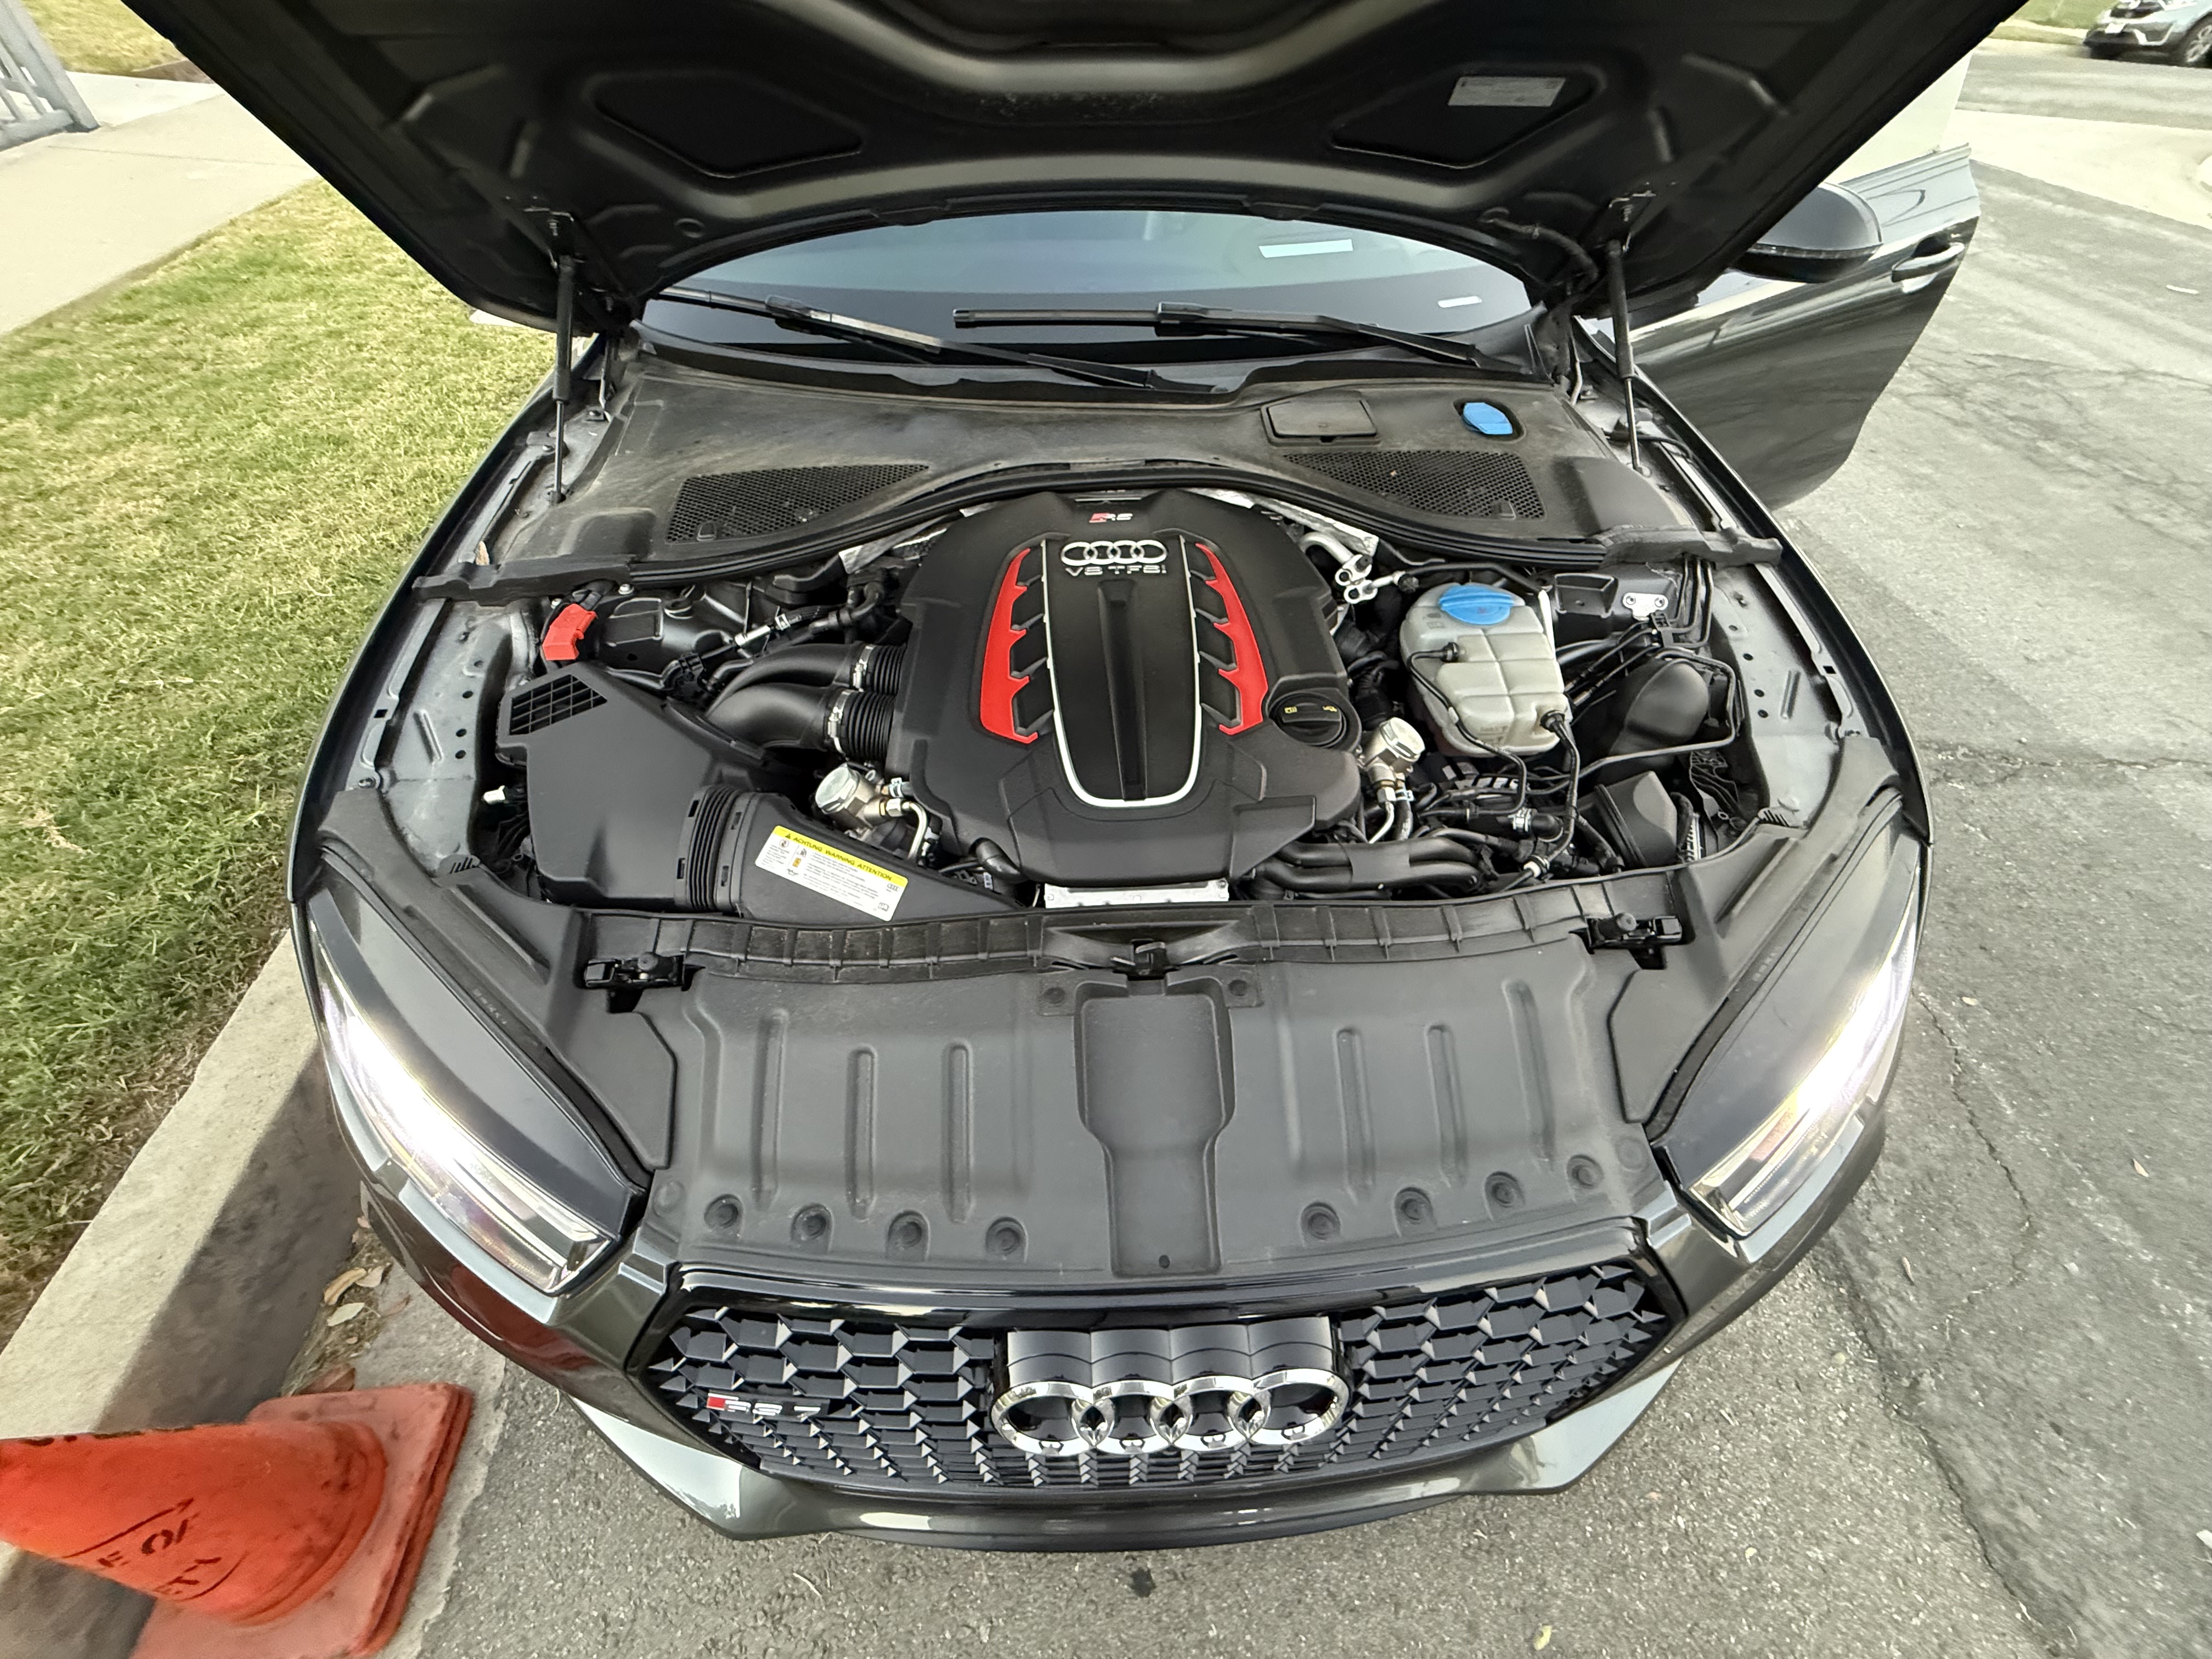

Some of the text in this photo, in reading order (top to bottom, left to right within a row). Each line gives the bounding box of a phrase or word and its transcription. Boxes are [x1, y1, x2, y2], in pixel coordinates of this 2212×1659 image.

[1088, 512, 1133, 523] RS
[1065, 566, 1103, 577] V8
[793, 837, 892, 881] ACHTUNG WARNING ATTENTION
